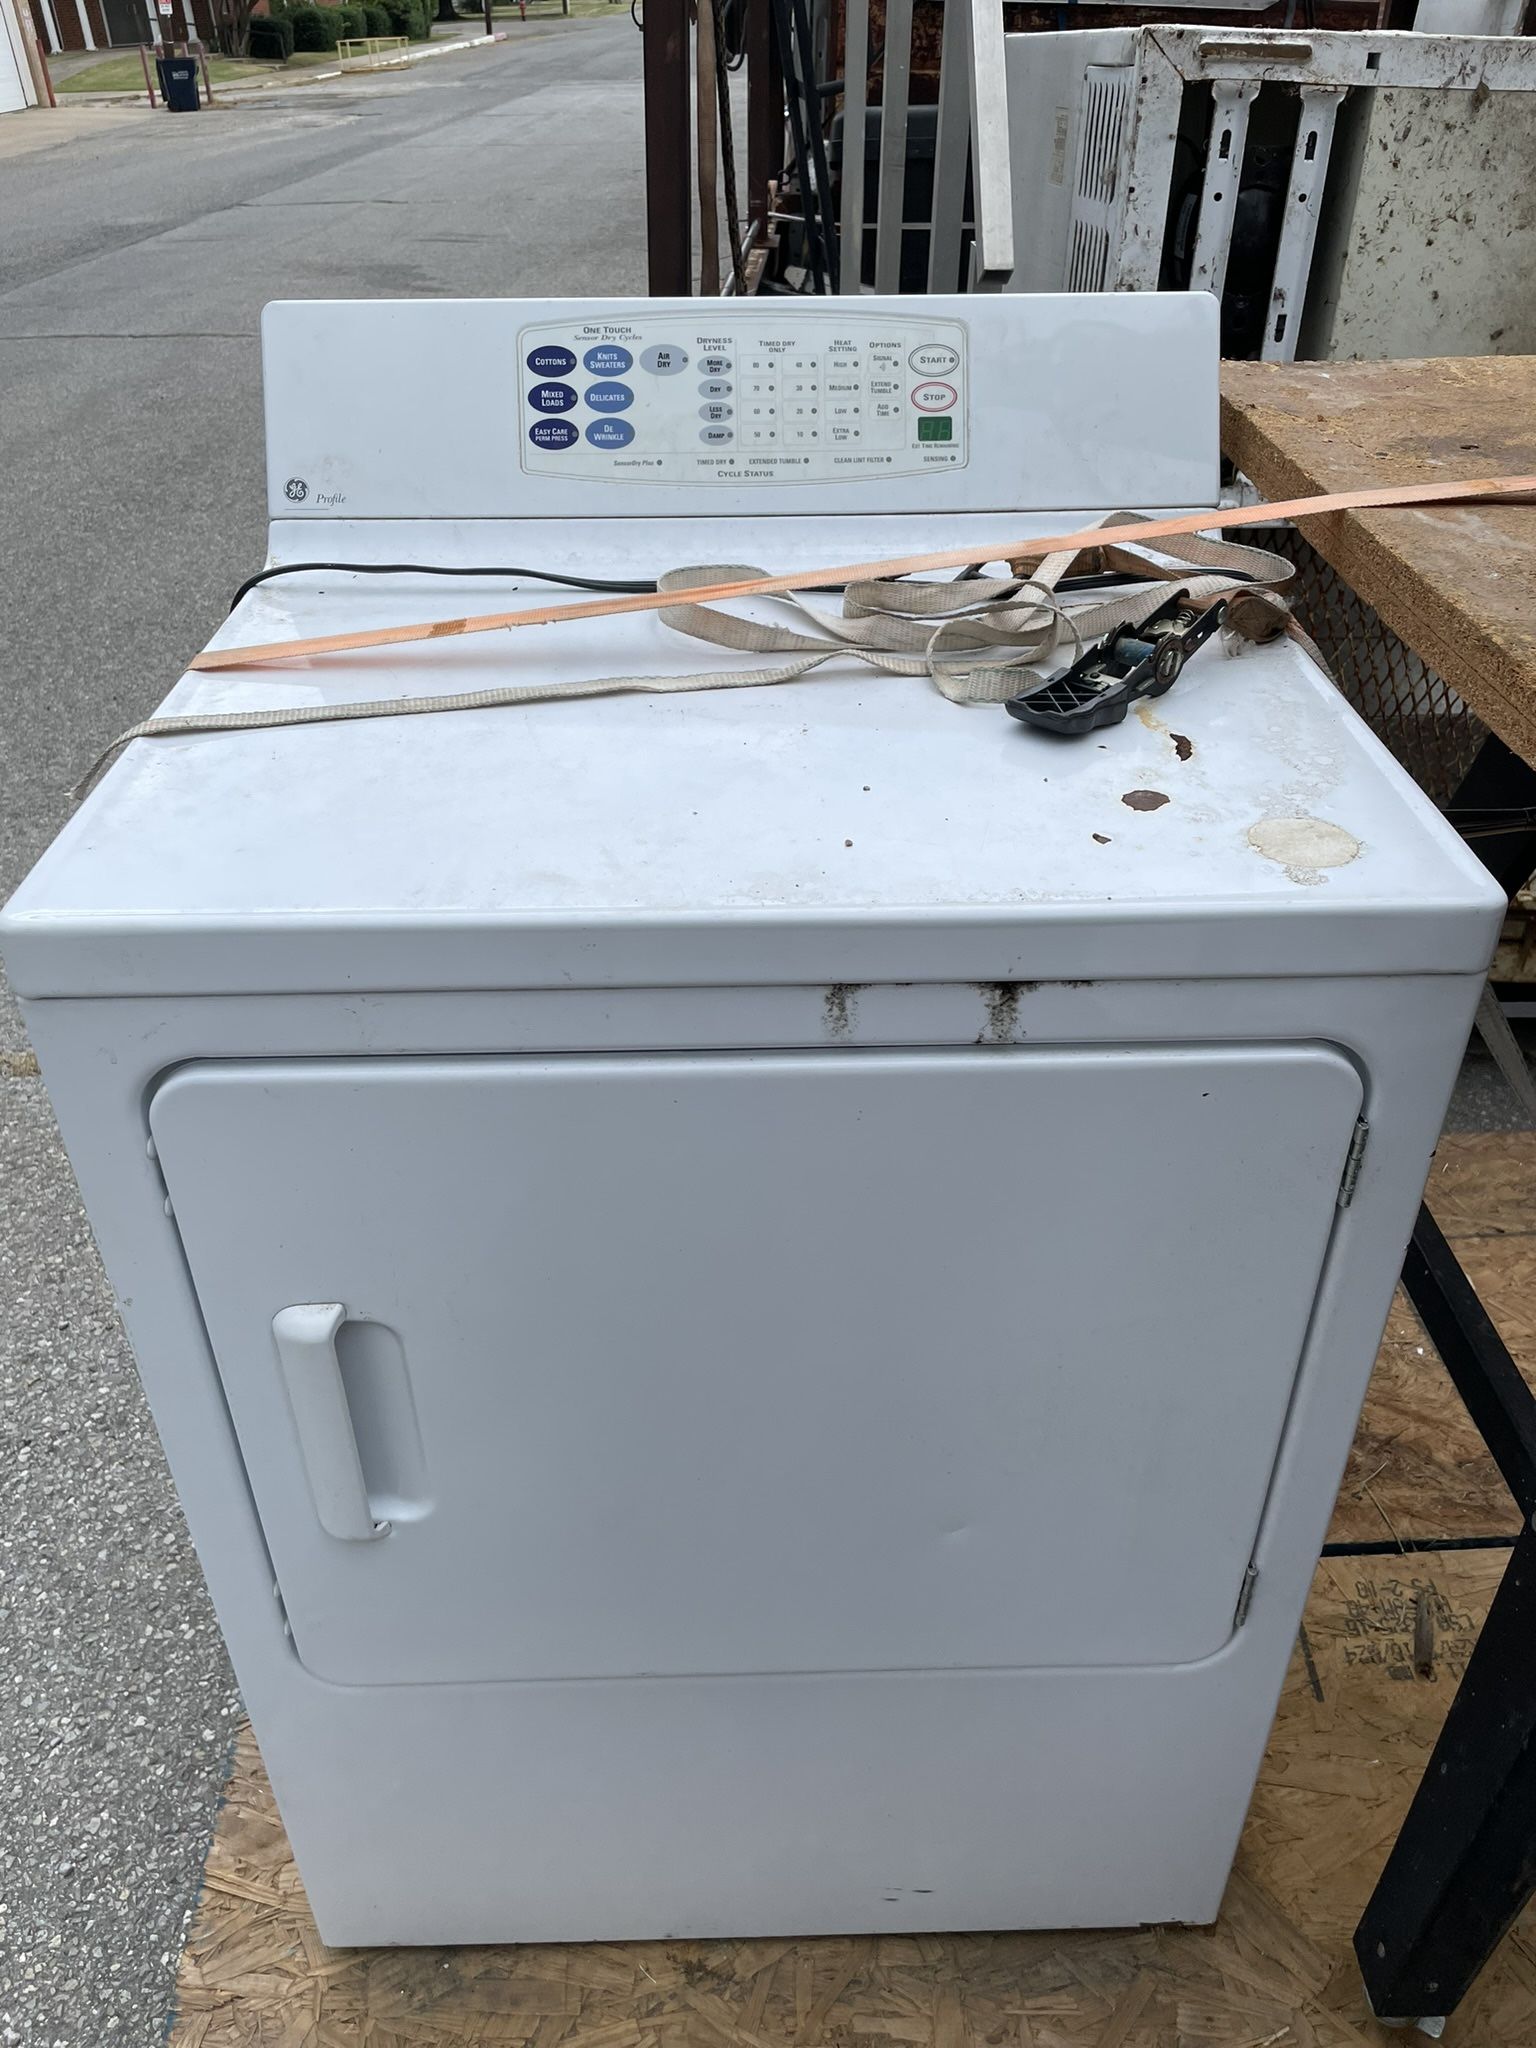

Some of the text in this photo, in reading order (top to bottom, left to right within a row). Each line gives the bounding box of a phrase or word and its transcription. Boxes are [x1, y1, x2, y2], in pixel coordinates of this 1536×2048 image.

[583, 326, 632, 334] ONE TOUCH
[869, 341, 902, 349] OPTIONS
[597, 352, 618, 361] KNITS
[657, 352, 671, 360] AIR
[920, 356, 947, 364] START
[535, 357, 567, 366] COTTONS
[590, 361, 626, 369] SWEATERS
[657, 360, 671, 368] DRY
[541, 390, 564, 398] MIXED
[590, 393, 625, 402] DELICATES
[923, 393, 946, 401] STOP
[541, 398, 564, 407] LOADS
[552, 427, 568, 435] CARE
[603, 424, 613, 433] DE
[593, 433, 624, 441] WRINKLE
[717, 470, 741, 478] CYCLE
[316, 493, 346, 506] Profile
